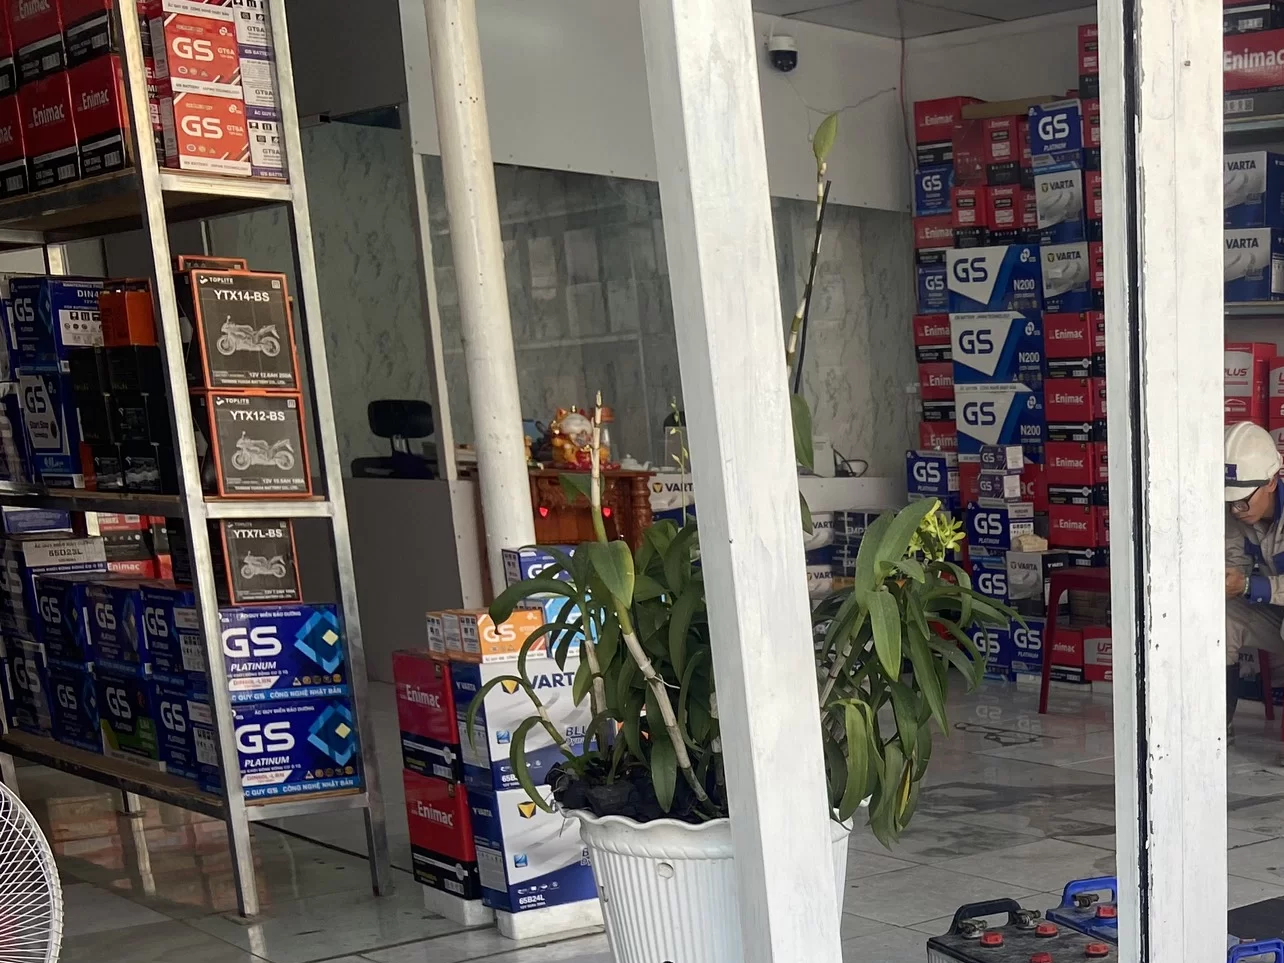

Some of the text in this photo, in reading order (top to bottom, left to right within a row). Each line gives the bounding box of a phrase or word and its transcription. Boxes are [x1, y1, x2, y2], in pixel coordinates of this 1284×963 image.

[172, 37, 214, 61] GS
[82, 88, 109, 110] Enimac
[32, 103, 65, 126] Enimac
[924, 114, 953, 127] Enimac
[181, 115, 223, 139] GS
[1038, 113, 1070, 140] GS
[1227, 160, 1256, 171] VARTA
[922, 175, 942, 191] GS
[1050, 180, 1075, 190] VARTA
[1226, 238, 1259, 249] VARTA
[1055, 251, 1081, 261] VARTA
[953, 257, 988, 282] GS
[925, 275, 944, 290] GS
[1013, 279, 1035, 290] N200
[214, 290, 270, 301] YTX14-BS
[959, 330, 993, 354] GS
[1055, 329, 1083, 339] Enimac
[1018, 352, 1040, 363] N200
[1055, 393, 1084, 404] Enimac
[230, 410, 285, 421] YTX12-BS
[963, 402, 996, 425] GS
[1020, 425, 1041, 436] N200
[982, 452, 995, 463] GS
[1055, 456, 1084, 468] Enimac
[913, 461, 941, 483] GS
[980, 481, 992, 491] GS
[974, 512, 1002, 535] GS
[1059, 519, 1087, 530] Enimac
[233, 529, 283, 538] YTX7L-BS
[1017, 561, 1038, 571] VARTA
[978, 572, 1007, 595] GS
[40, 597, 61, 623] GS
[95, 603, 117, 629] GS
[145, 607, 168, 637] GS
[483, 624, 516, 642] GS
[1013, 629, 1041, 651] GS
[222, 626, 282, 658] GS
[231, 662, 276, 672] PLATINUM
[406, 684, 441, 708] Enimac
[160, 702, 187, 732] GS
[236, 721, 295, 754] GS
[244, 756, 289, 767] PLATINUM
[417, 801, 454, 827] Enimac
